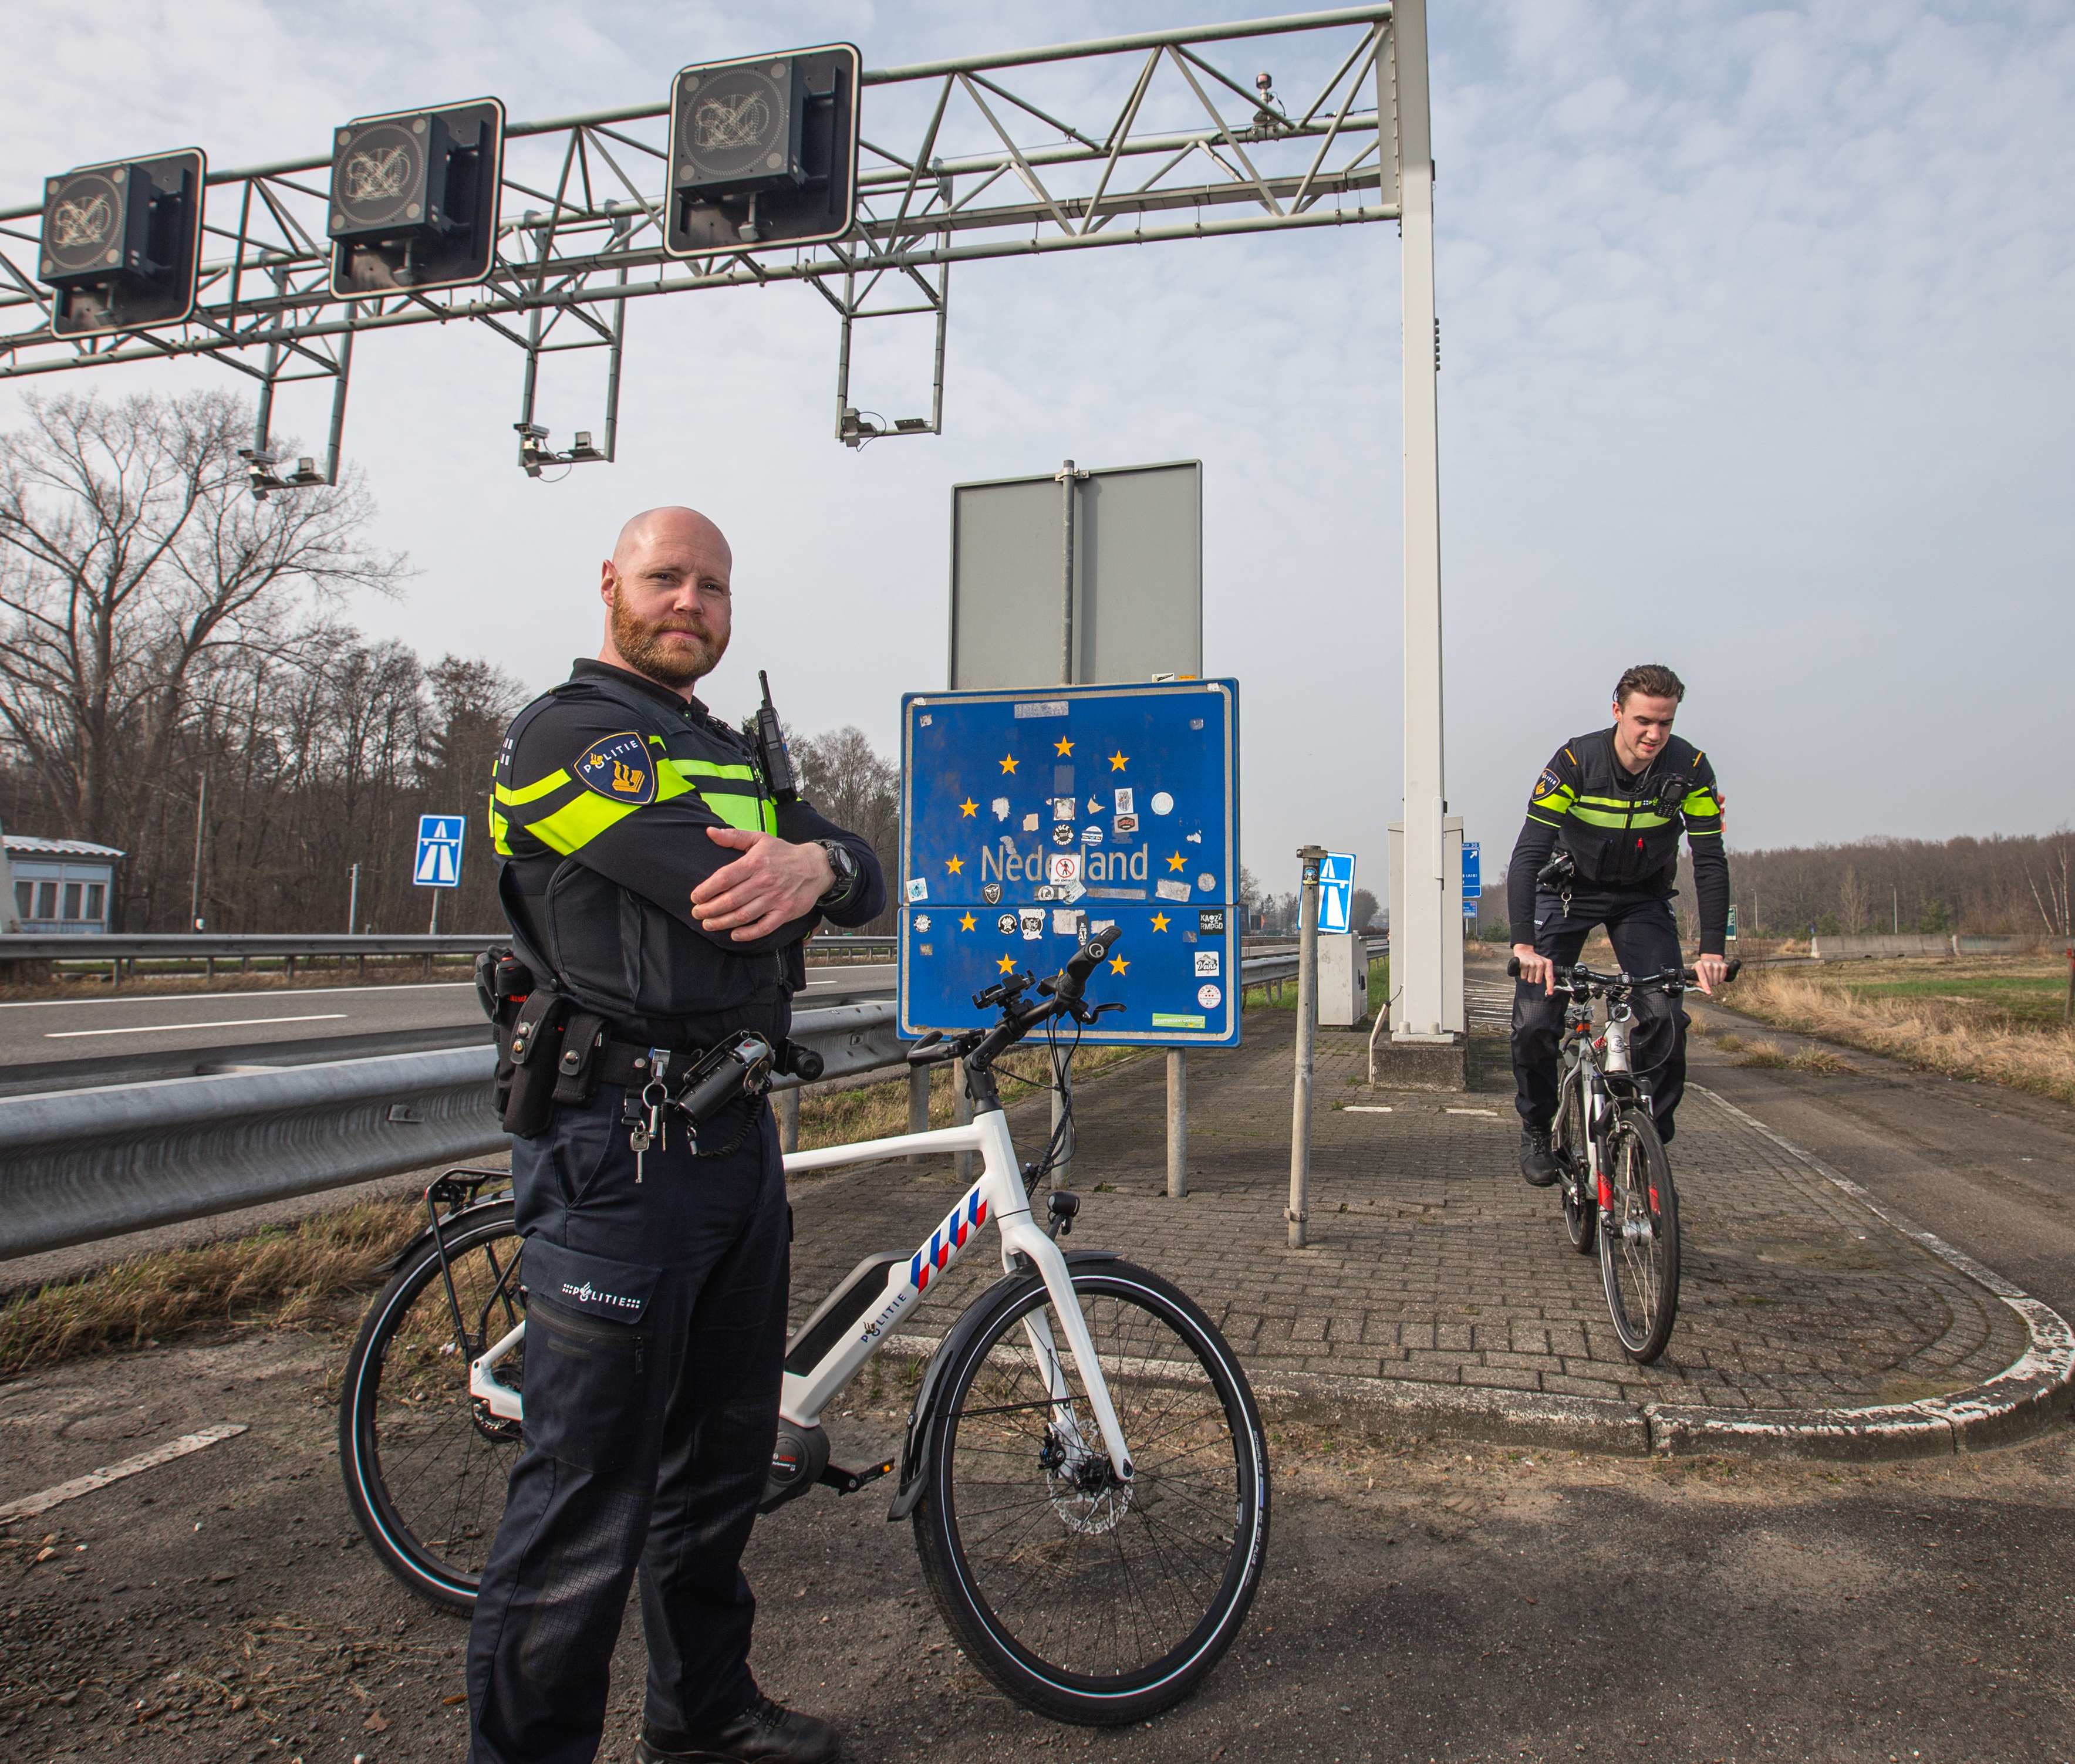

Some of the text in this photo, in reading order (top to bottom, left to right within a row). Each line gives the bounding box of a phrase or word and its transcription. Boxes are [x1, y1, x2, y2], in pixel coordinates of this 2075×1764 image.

[583, 740, 639, 773] POLITIE
[981, 843, 1148, 881] Nedland
[572, 1286, 626, 1306] POLITIE
[860, 1293, 907, 1343] POLITIE
